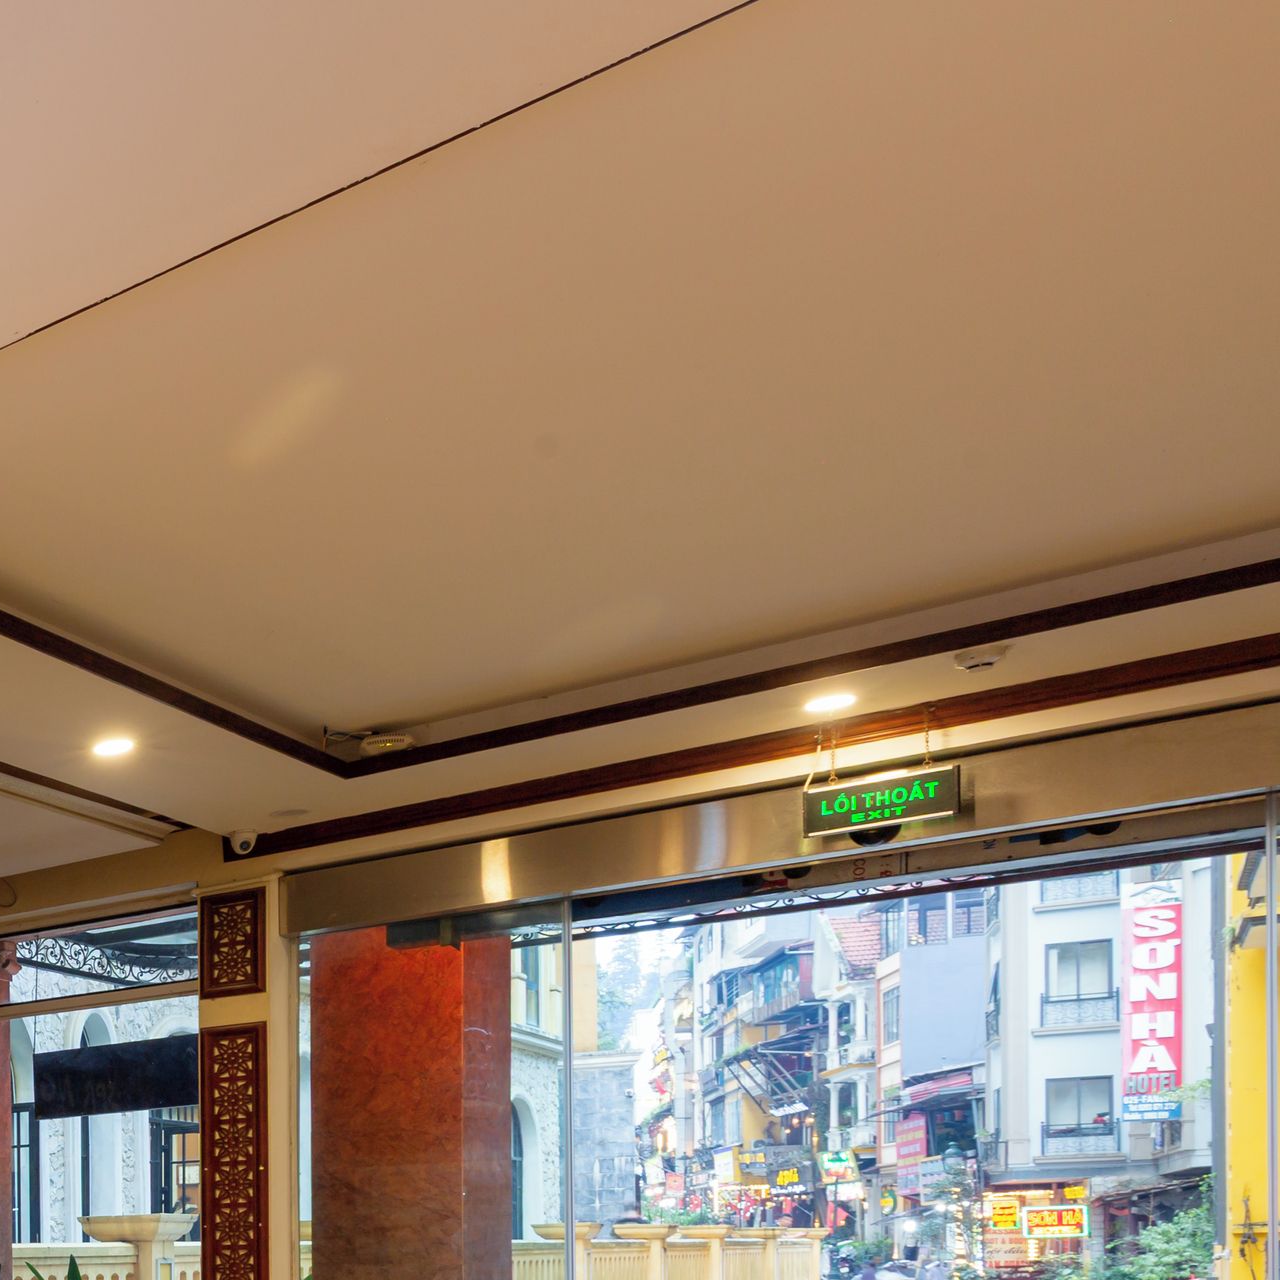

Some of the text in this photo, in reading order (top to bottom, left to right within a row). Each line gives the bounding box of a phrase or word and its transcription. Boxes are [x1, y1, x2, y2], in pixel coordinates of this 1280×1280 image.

[821, 780, 939, 816] LỐI THOÁT
[851, 805, 906, 823] EXIT
[1129, 908, 1181, 1002] SƠN
[1127, 1010, 1177, 1074] HÀ
[1125, 1073, 1178, 1094] HOTEL
